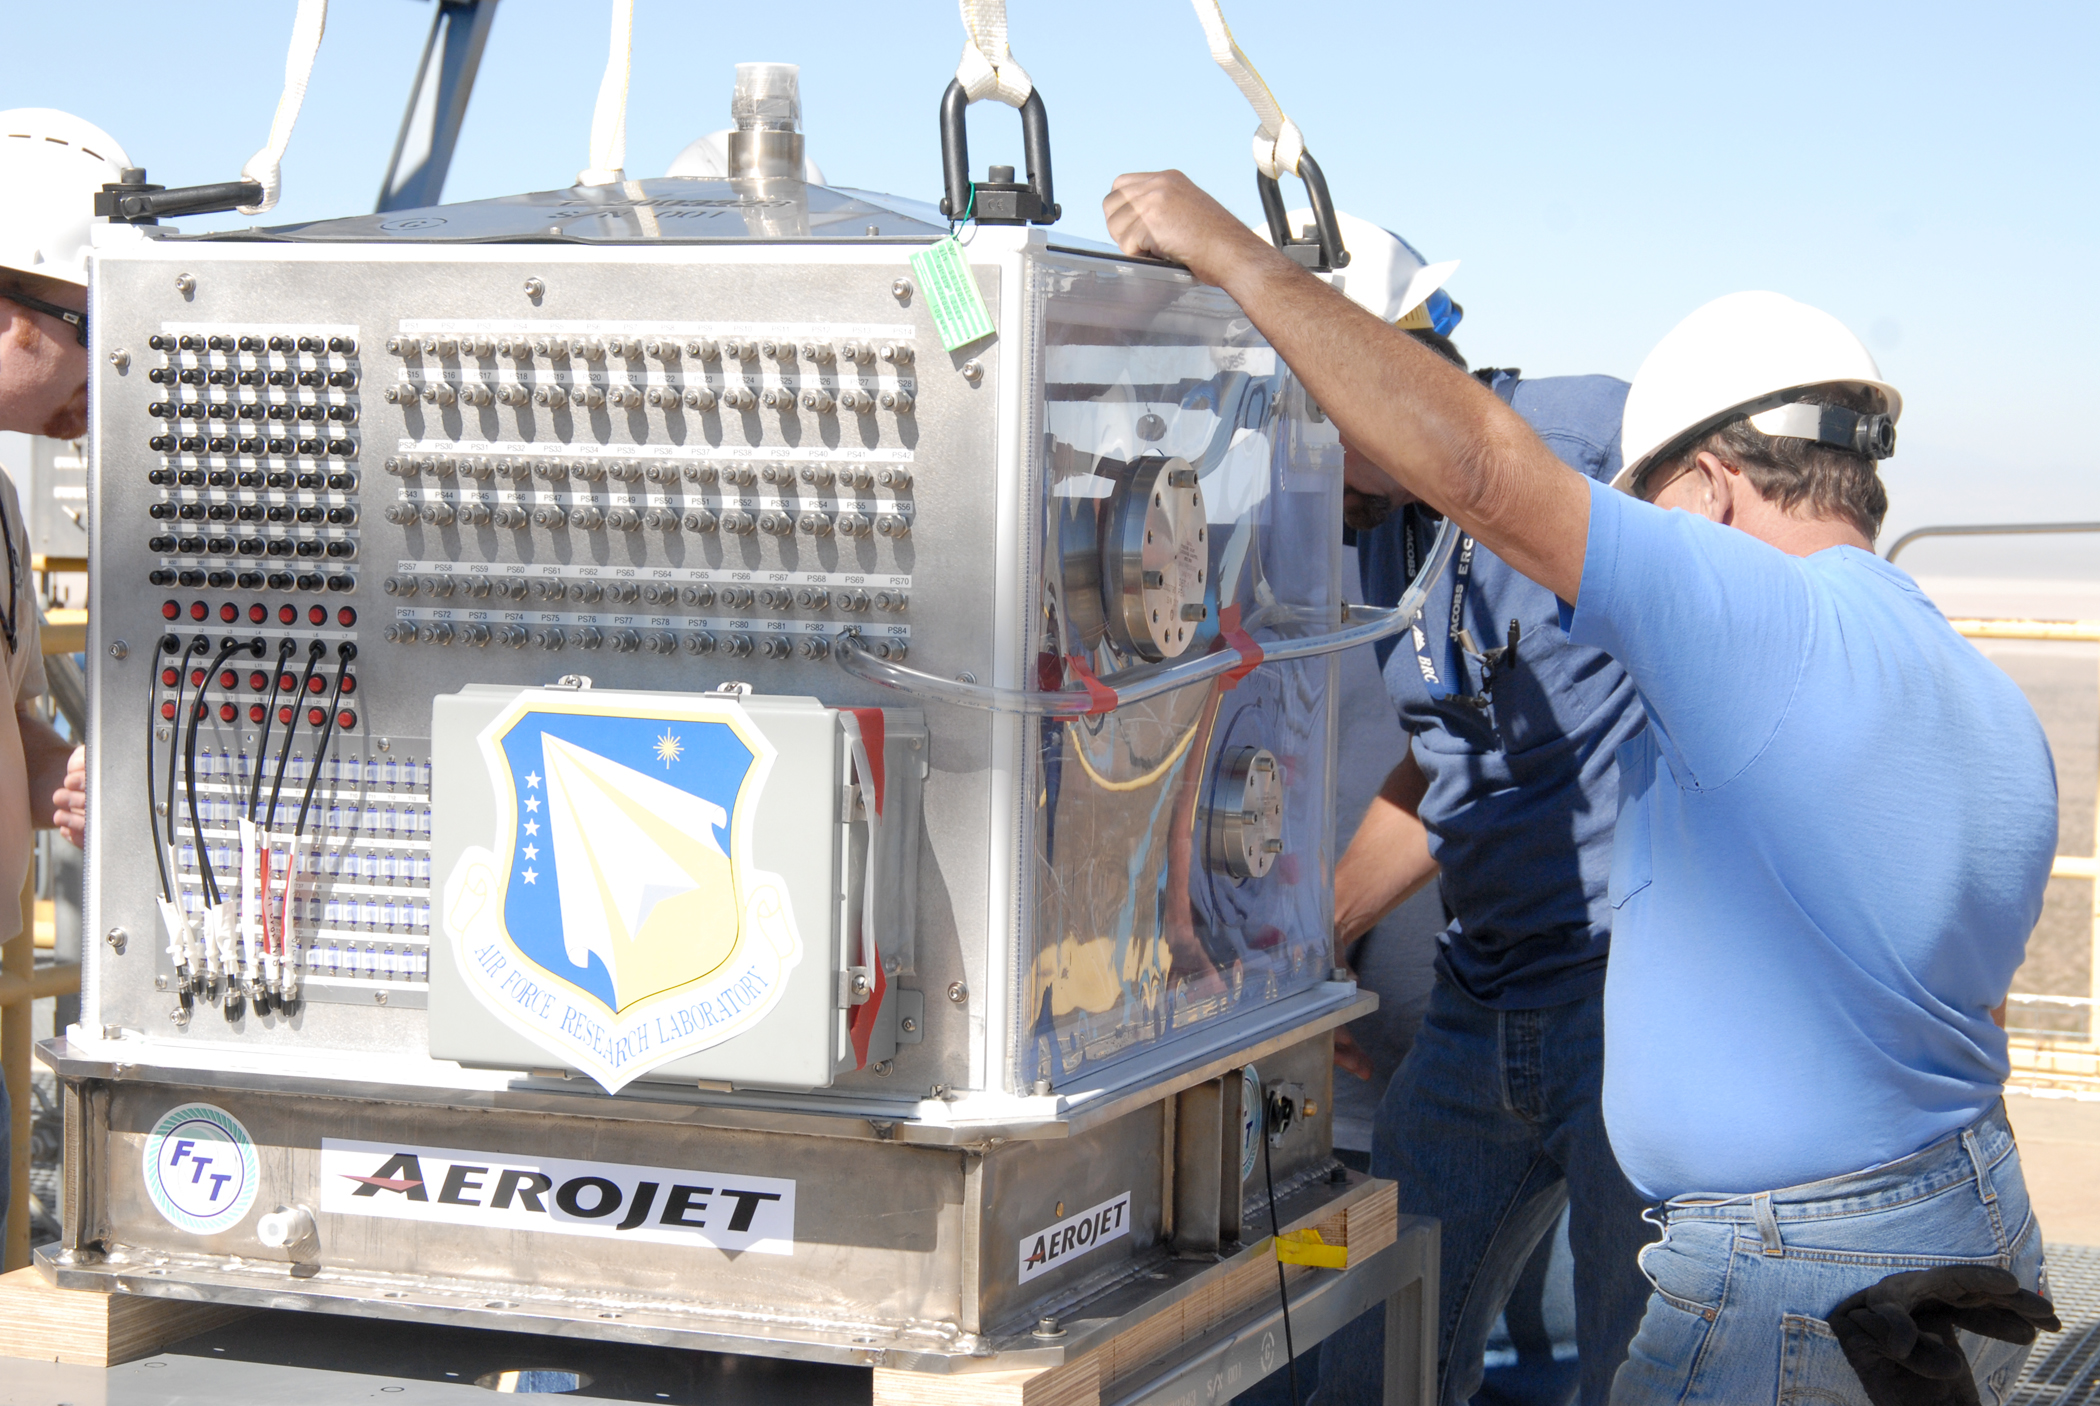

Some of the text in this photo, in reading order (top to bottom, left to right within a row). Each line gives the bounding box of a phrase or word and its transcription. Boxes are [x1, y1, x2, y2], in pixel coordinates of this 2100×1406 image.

[398, 562, 417, 570] PS57
[434, 564, 452, 572] PS58
[470, 564, 488, 573] PS59
[506, 566, 525, 574] PS60
[542, 566, 561, 574] PS61
[579, 568, 598, 576] PS62
[616, 569, 635, 577] PS63
[690, 571, 709, 579] PS65
[731, 572, 751, 580] PS66
[769, 573, 788, 582] PS67
[806, 574, 826, 583] PS68
[844, 576, 864, 584] PS69
[889, 577, 910, 585] PS70
[1450, 538, 1474, 642] JACOBS ERC
[397, 609, 415, 617] PS71
[432, 610, 451, 618] PS72
[468, 611, 487, 620] PS73
[504, 612, 524, 620] PS74
[541, 614, 560, 622] PS75
[577, 615, 596, 623] PS76
[614, 616, 633, 624] PS77
[651, 618, 670, 626] PS78
[688, 619, 708, 627] PS79
[729, 620, 749, 629] PS80
[767, 622, 786, 630] PS81
[805, 623, 824, 632] PS82
[887, 626, 907, 634] PS84
[474, 943, 769, 1068] AIR FORCE RESEARCH LABORATORY
[170, 1140, 232, 1202] FTT
[340, 1152, 781, 1232] AEROJET
[1024, 1200, 1127, 1272] AEROJET
